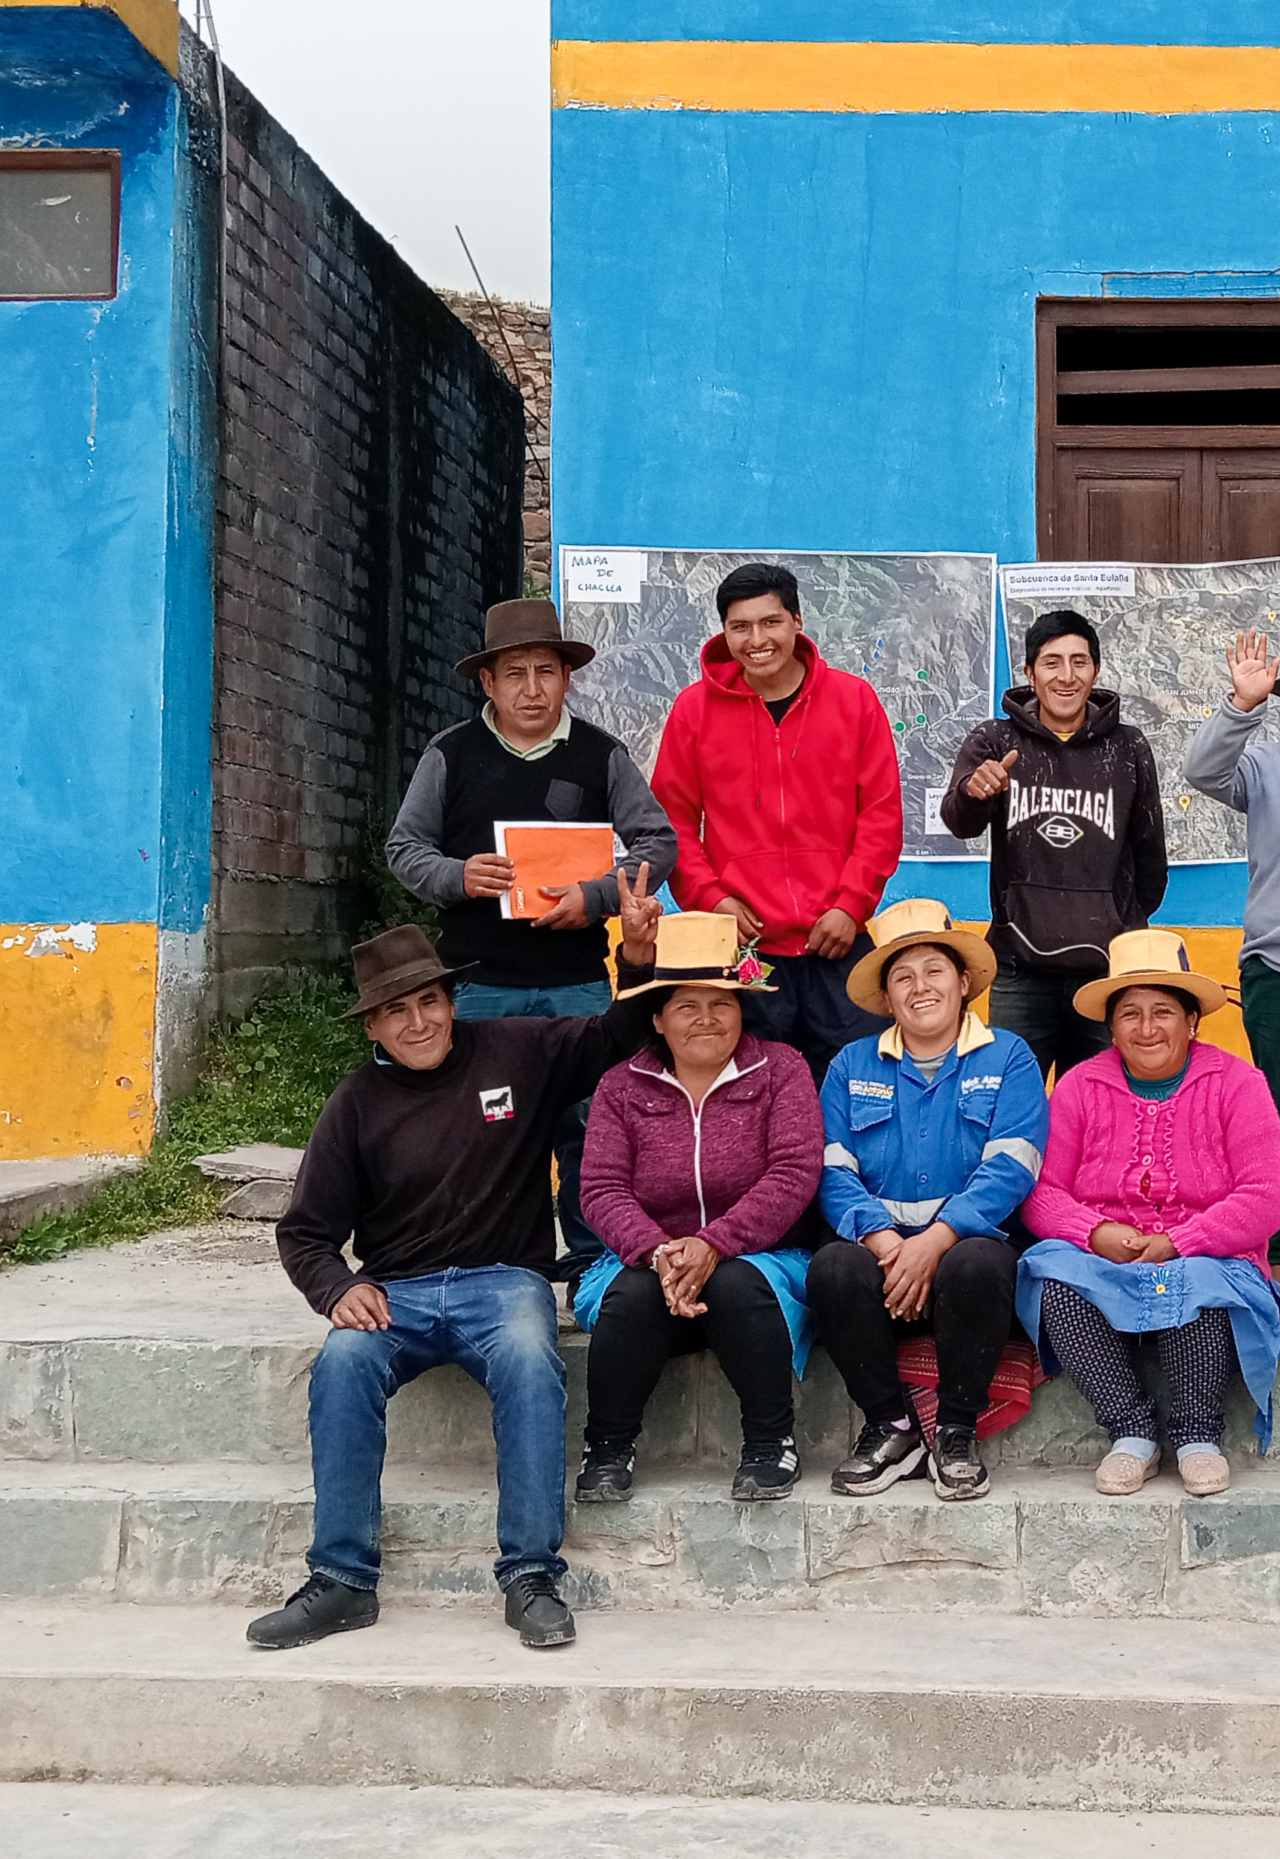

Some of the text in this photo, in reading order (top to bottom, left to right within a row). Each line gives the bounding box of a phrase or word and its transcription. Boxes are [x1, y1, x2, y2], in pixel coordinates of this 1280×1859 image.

[571, 556, 608, 567] MAPA
[596, 569, 614, 577] DE
[1010, 574, 1059, 584] Subcuenca
[1060, 574, 1072, 582] de
[1073, 573, 1098, 582] Santa
[1007, 779, 1115, 840] BALENCIAGA
